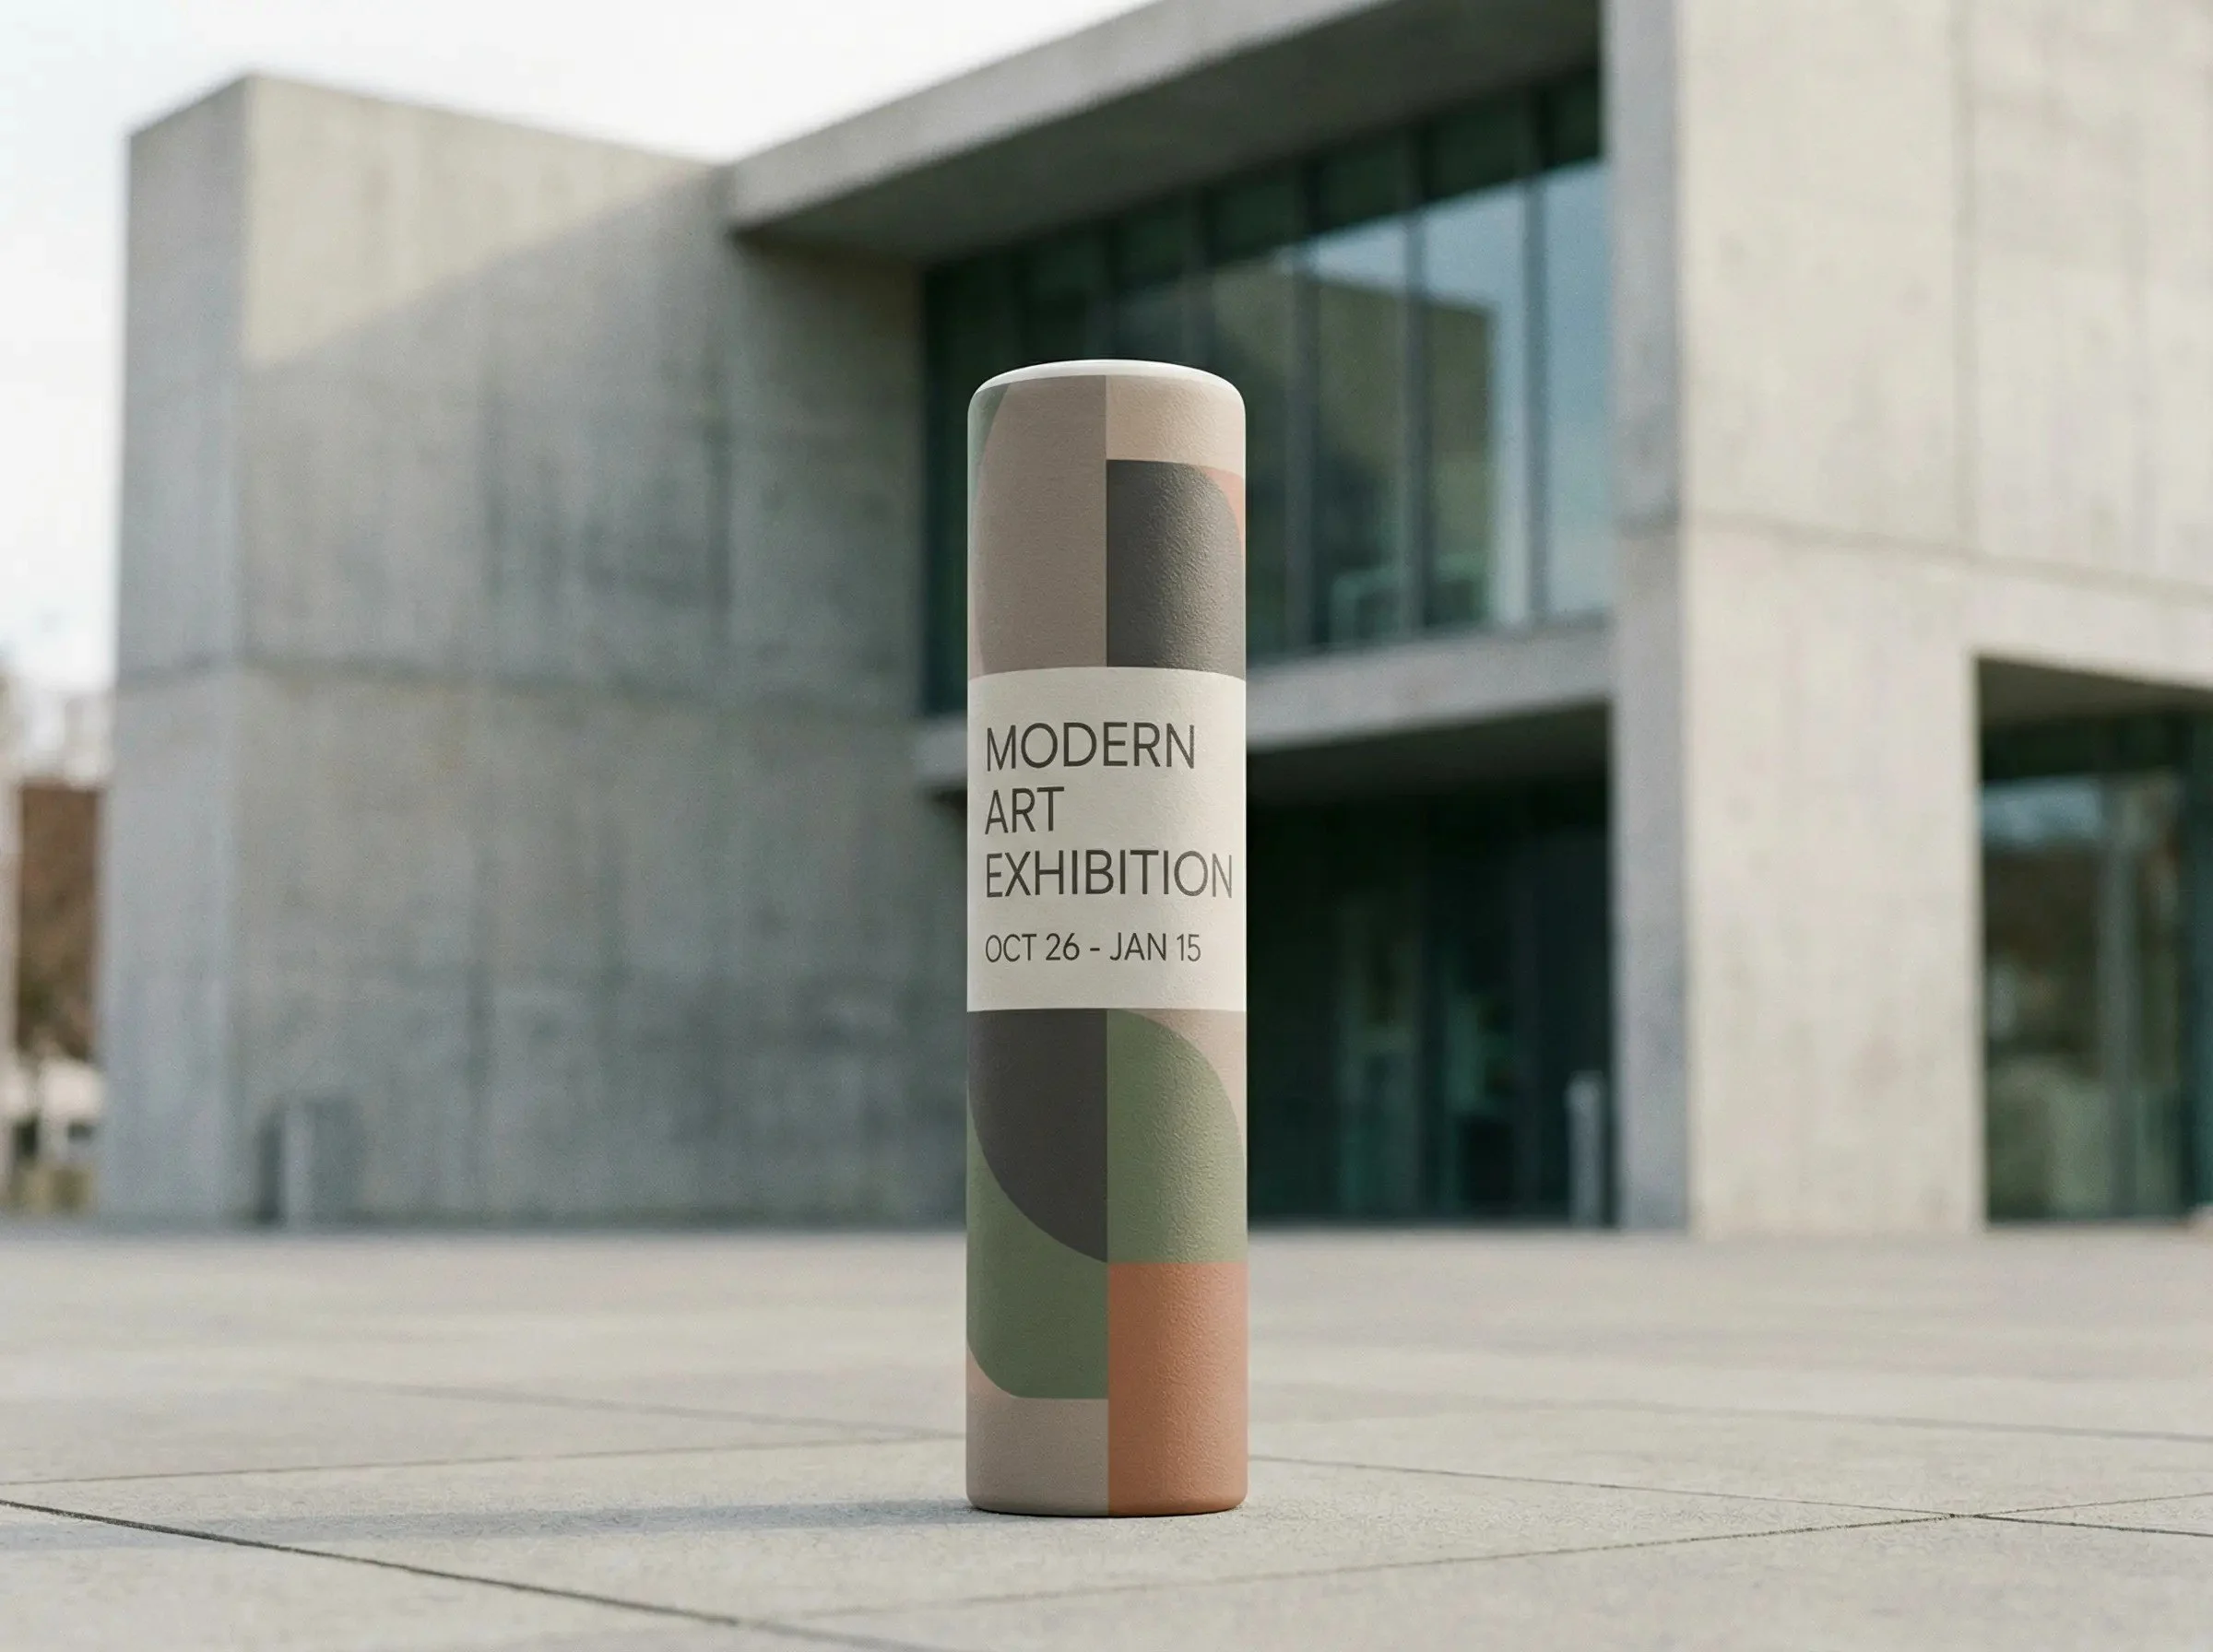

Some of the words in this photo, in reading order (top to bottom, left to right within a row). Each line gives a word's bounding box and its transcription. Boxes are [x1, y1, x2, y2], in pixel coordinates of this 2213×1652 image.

[987, 721, 1195, 772] MODERN
[985, 785, 1065, 834] ART
[986, 849, 1233, 899] EXHIBITION
[985, 933, 1037, 962] OCT
[1045, 932, 1080, 962] 26
[1109, 932, 1167, 962] JAN
[1176, 933, 1201, 962] 15
